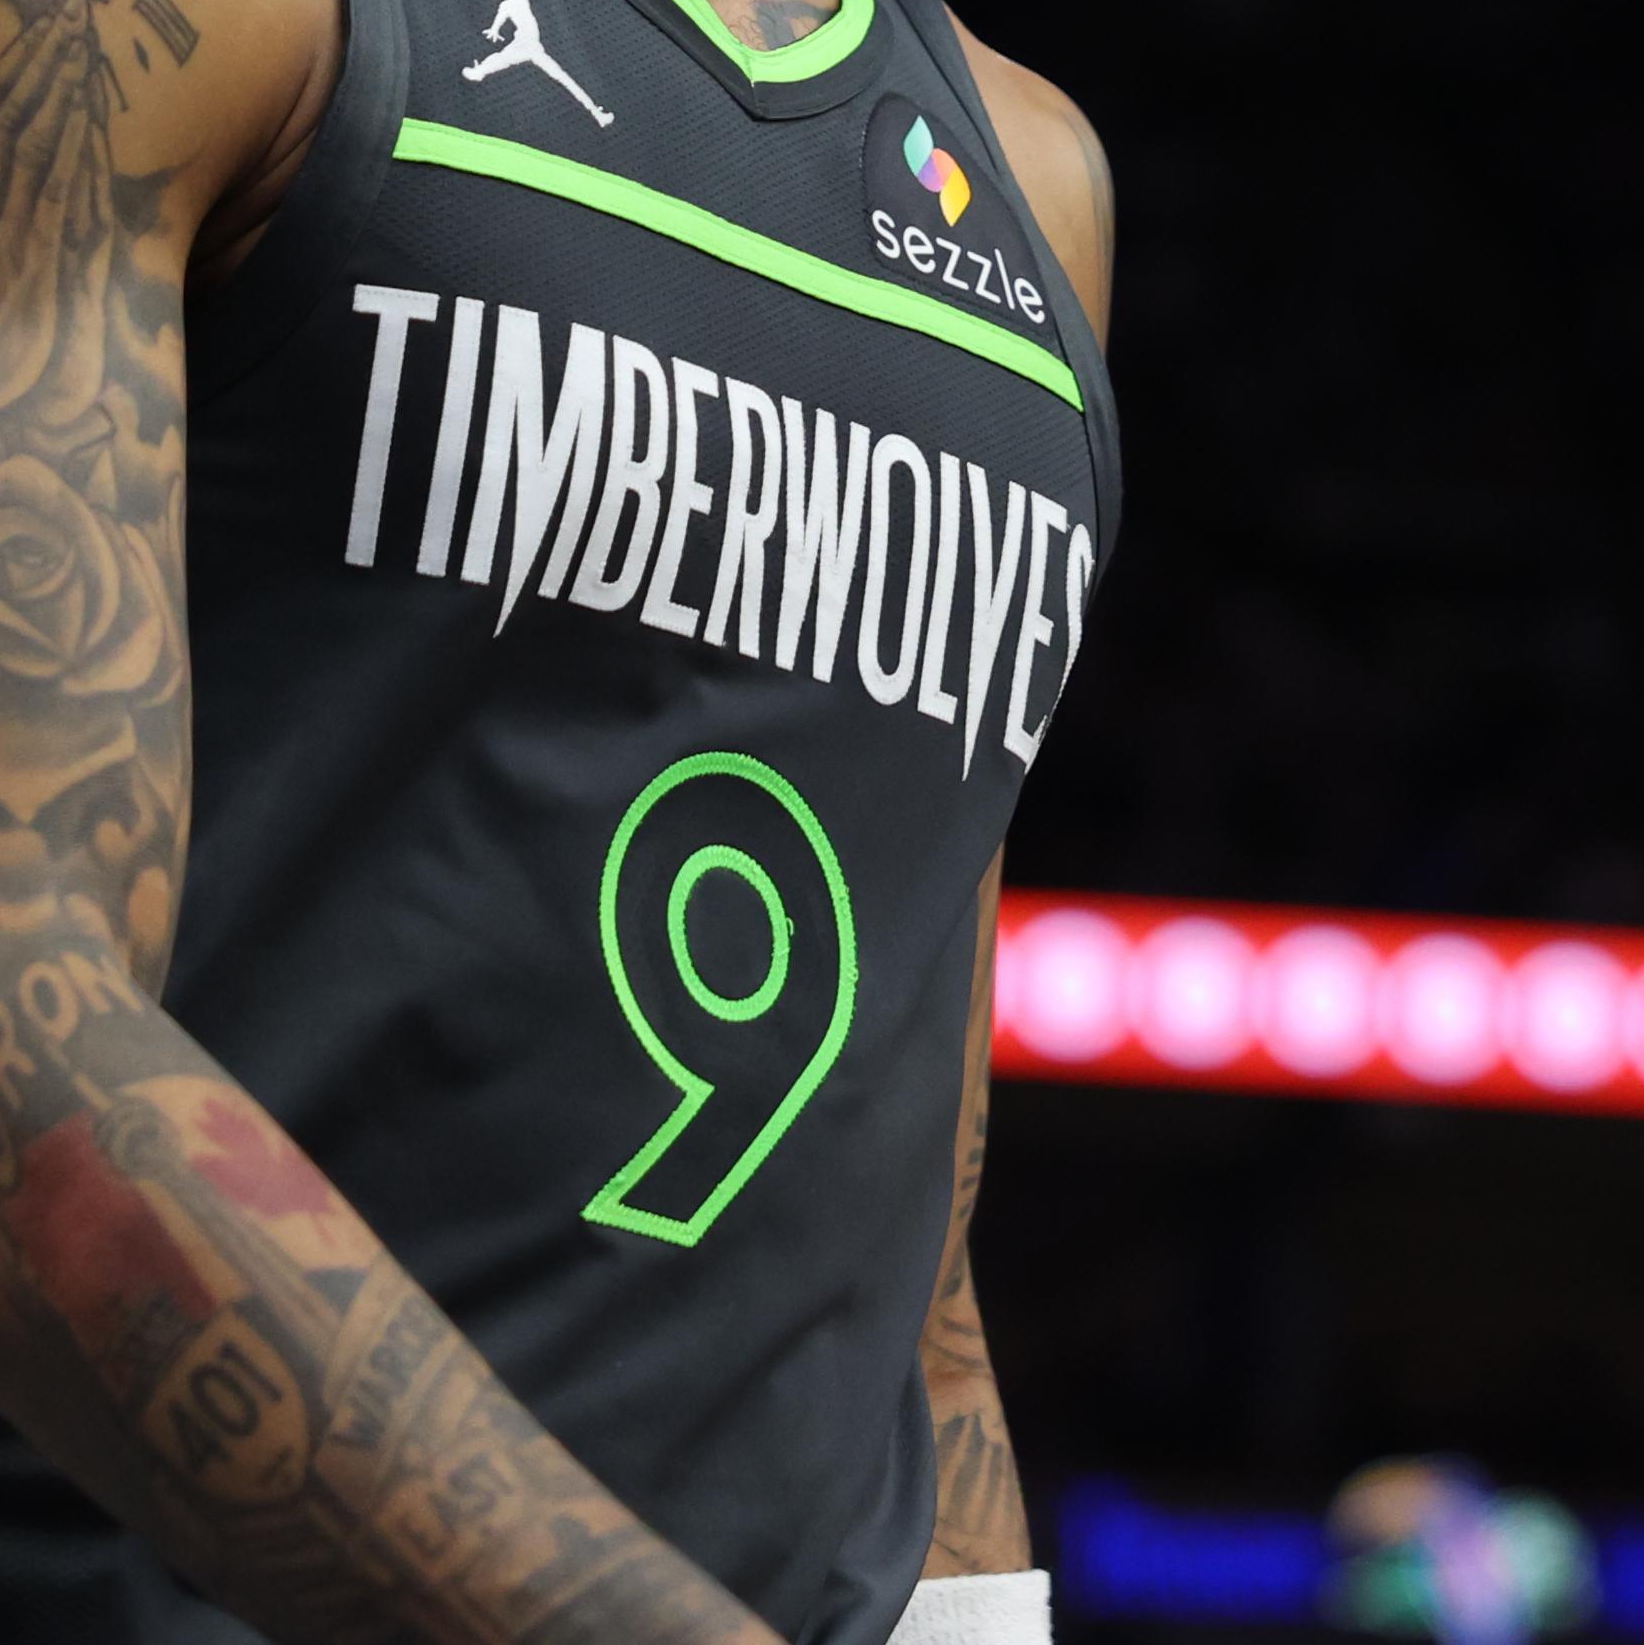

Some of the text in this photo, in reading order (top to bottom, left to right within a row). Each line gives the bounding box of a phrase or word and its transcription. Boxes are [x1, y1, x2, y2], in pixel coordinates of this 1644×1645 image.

[871, 208, 1046, 325] sezzle
[581, 751, 859, 1248] 9
[166, 1340, 284, 1473] 401
